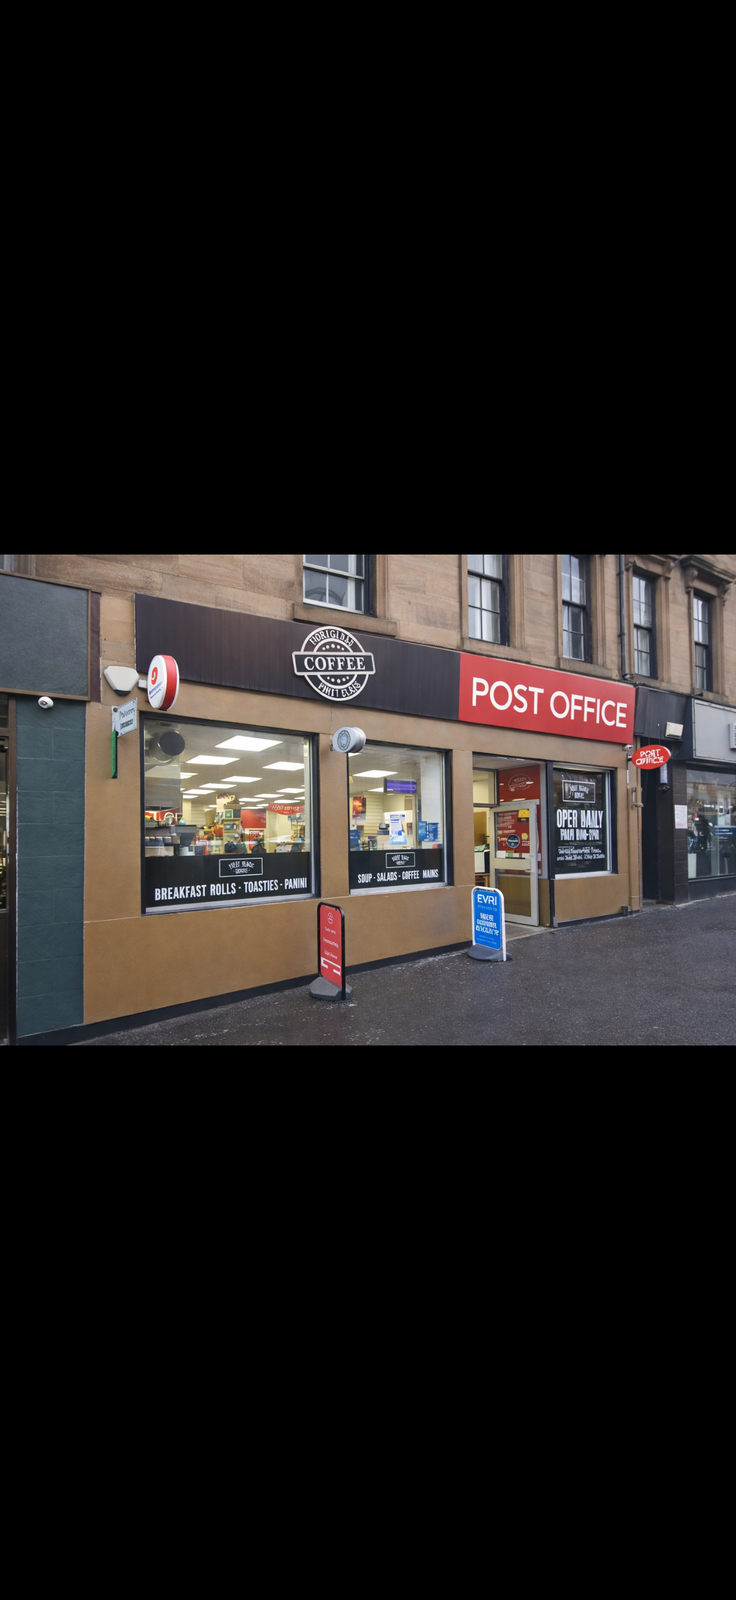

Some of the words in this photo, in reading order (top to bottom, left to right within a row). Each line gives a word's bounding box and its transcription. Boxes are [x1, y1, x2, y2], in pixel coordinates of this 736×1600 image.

[303, 656, 366, 671] COFFEE
[472, 676, 545, 715] POST
[550, 690, 628, 729] OFFICE
[357, 873, 373, 884] SOUP
[376, 871, 398, 882] SALADS
[422, 868, 439, 879] MAINS
[154, 884, 207, 901] BREAKFAST
[209, 882, 237, 896] ROLLS
[243, 879, 279, 893] TOASTIES
[284, 877, 308, 890] PANINI
[477, 893, 497, 906] EVRI
